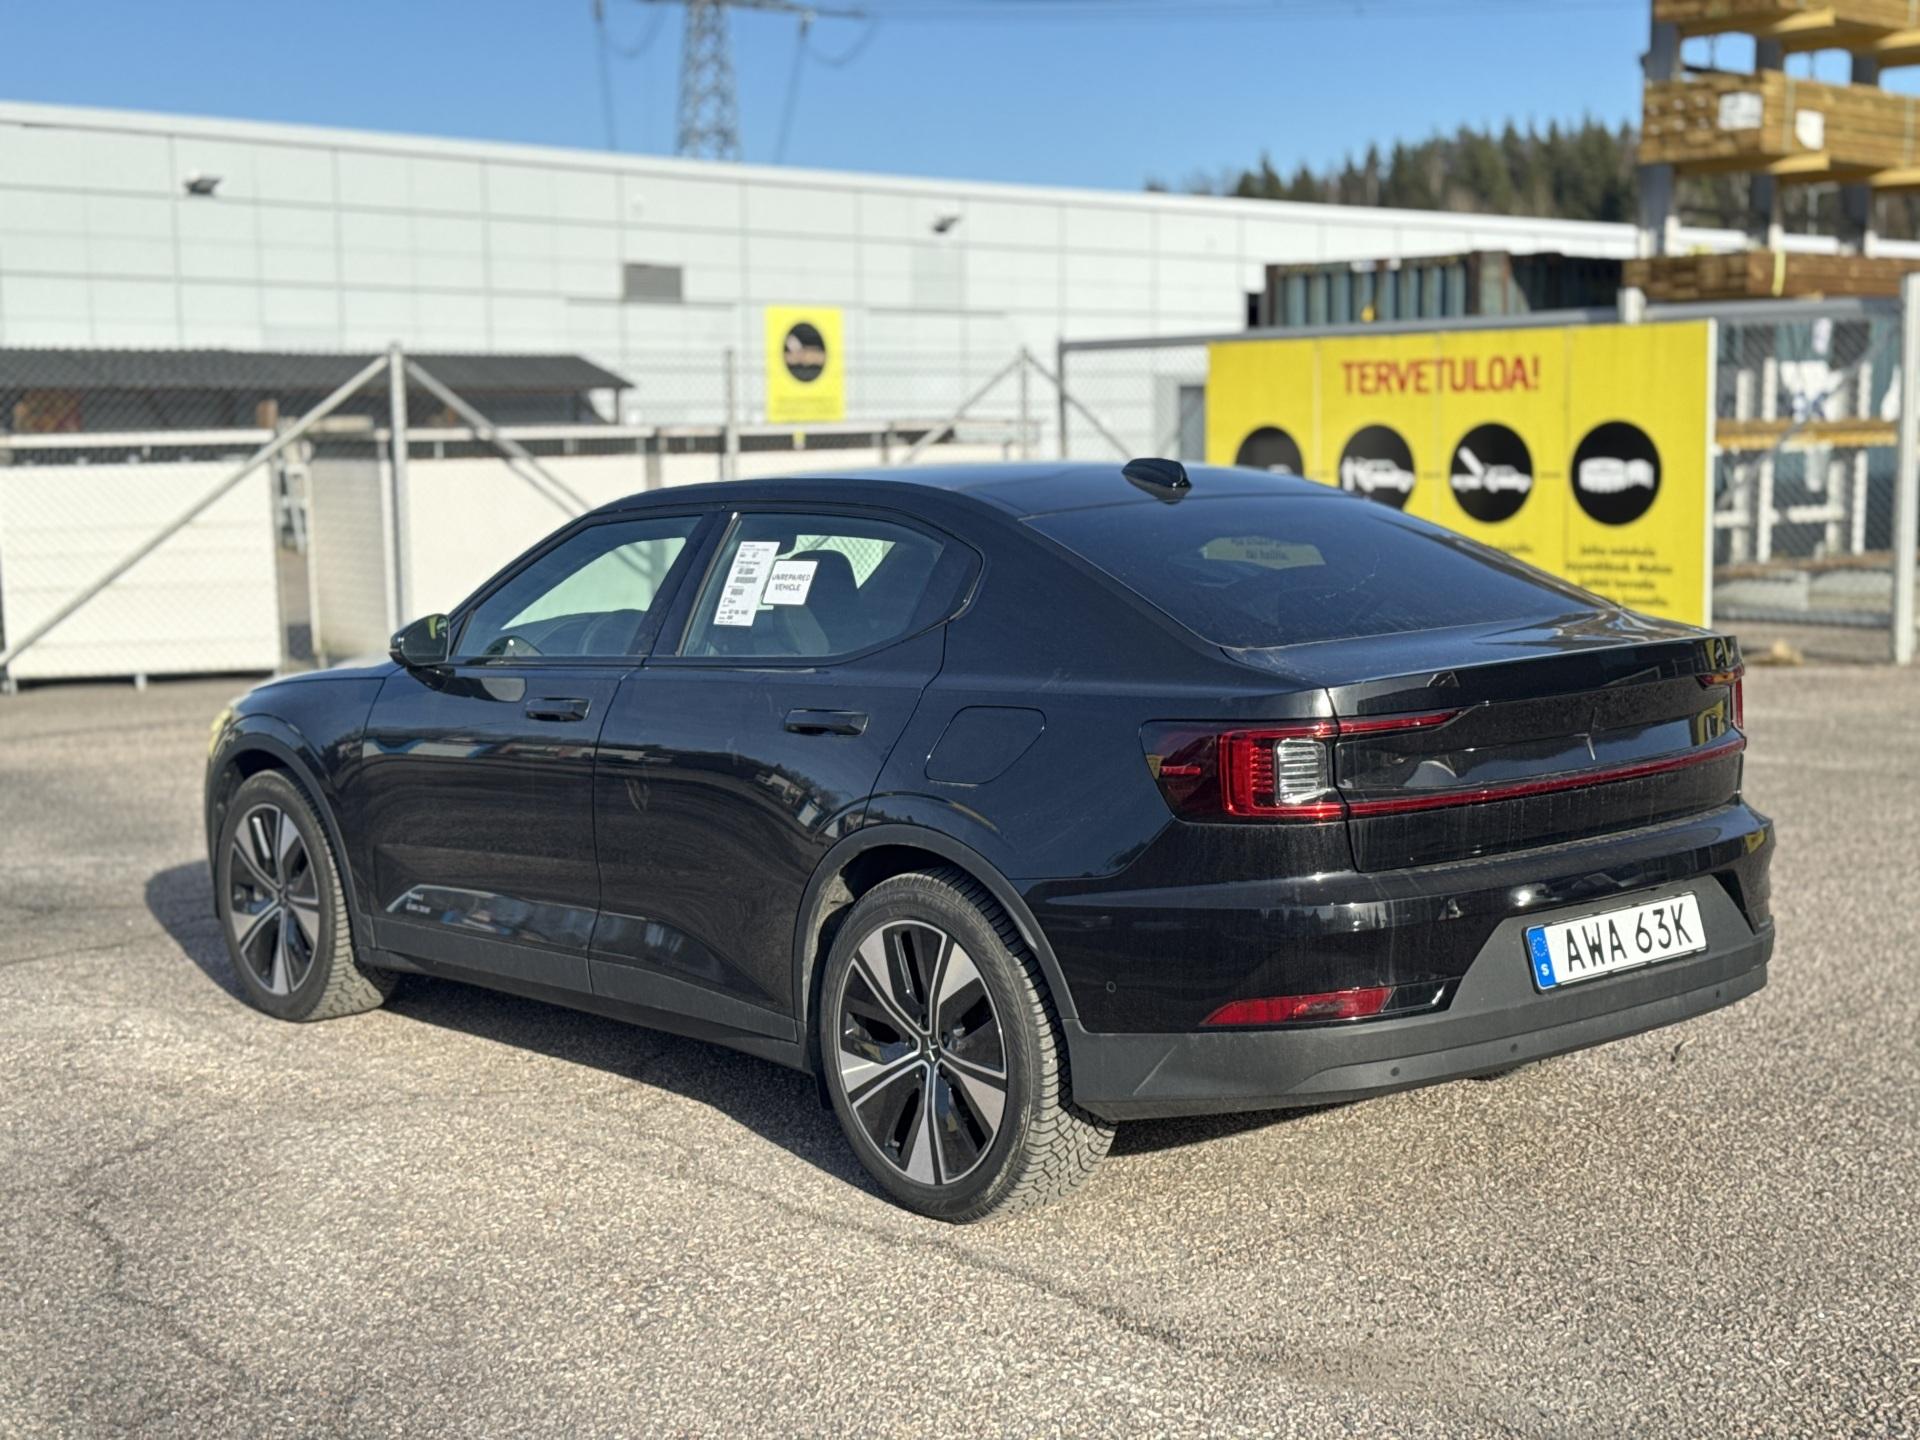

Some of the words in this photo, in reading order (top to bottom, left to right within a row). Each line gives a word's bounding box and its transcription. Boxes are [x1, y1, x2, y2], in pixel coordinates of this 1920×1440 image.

[1342, 355, 1540, 396] TERVETULOA!
[771, 573, 811, 583] UNREPAIRED
[774, 583, 801, 592] VEHICLE
[1566, 918, 1628, 973] AWA
[1634, 902, 1693, 954] 63K
[1539, 964, 1550, 977] S
